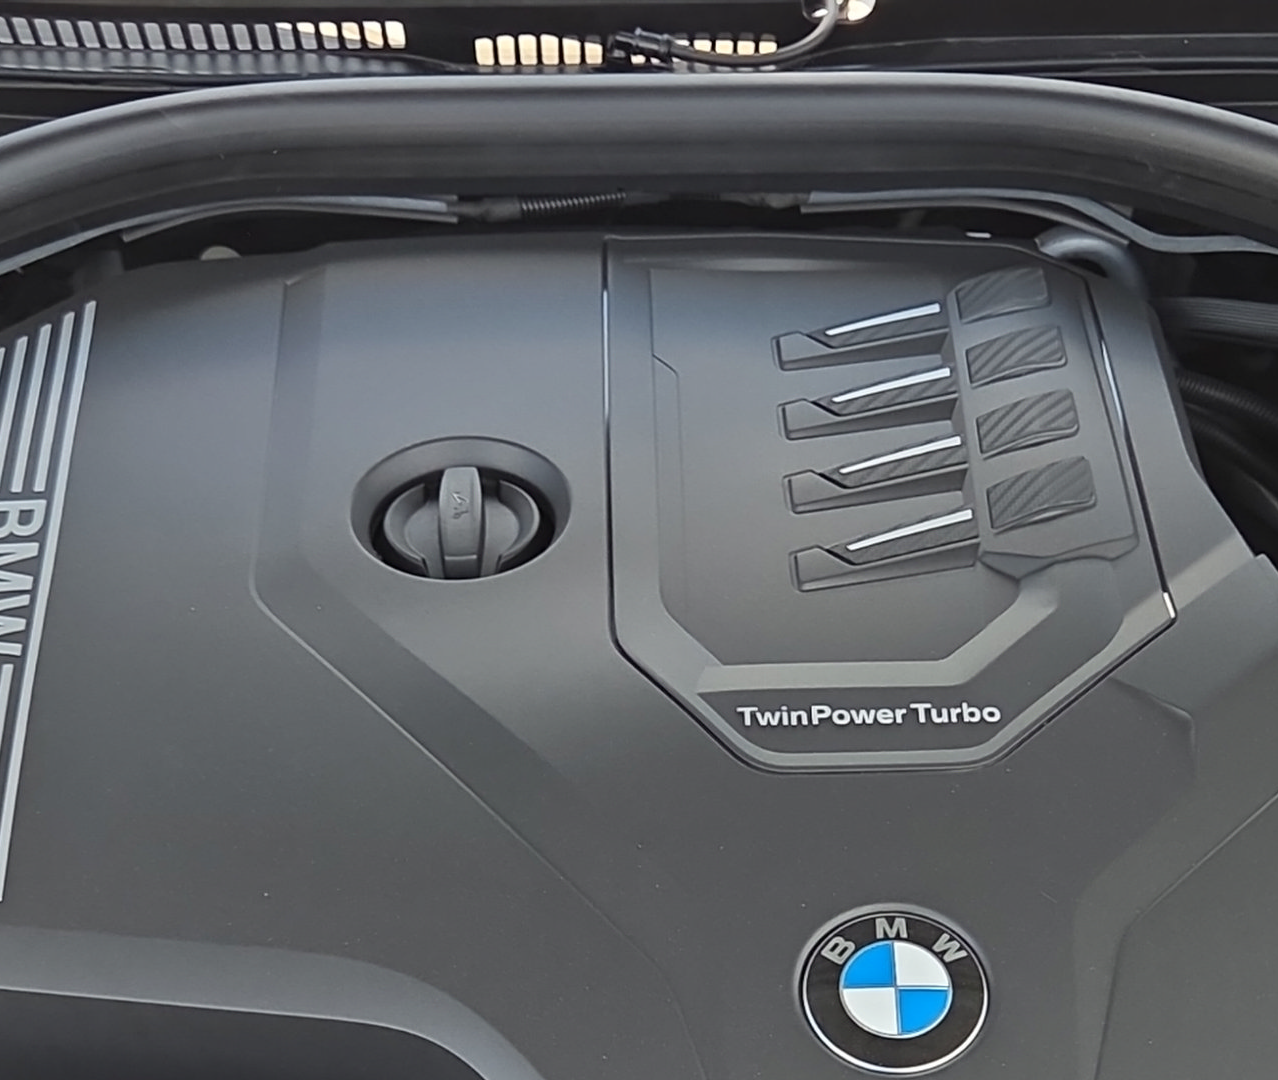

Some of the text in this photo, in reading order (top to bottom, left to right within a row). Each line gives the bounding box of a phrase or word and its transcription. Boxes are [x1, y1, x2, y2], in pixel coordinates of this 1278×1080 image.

[736, 701, 1002, 727] TwinPower Turbo
[820, 917, 969, 966] BMW
